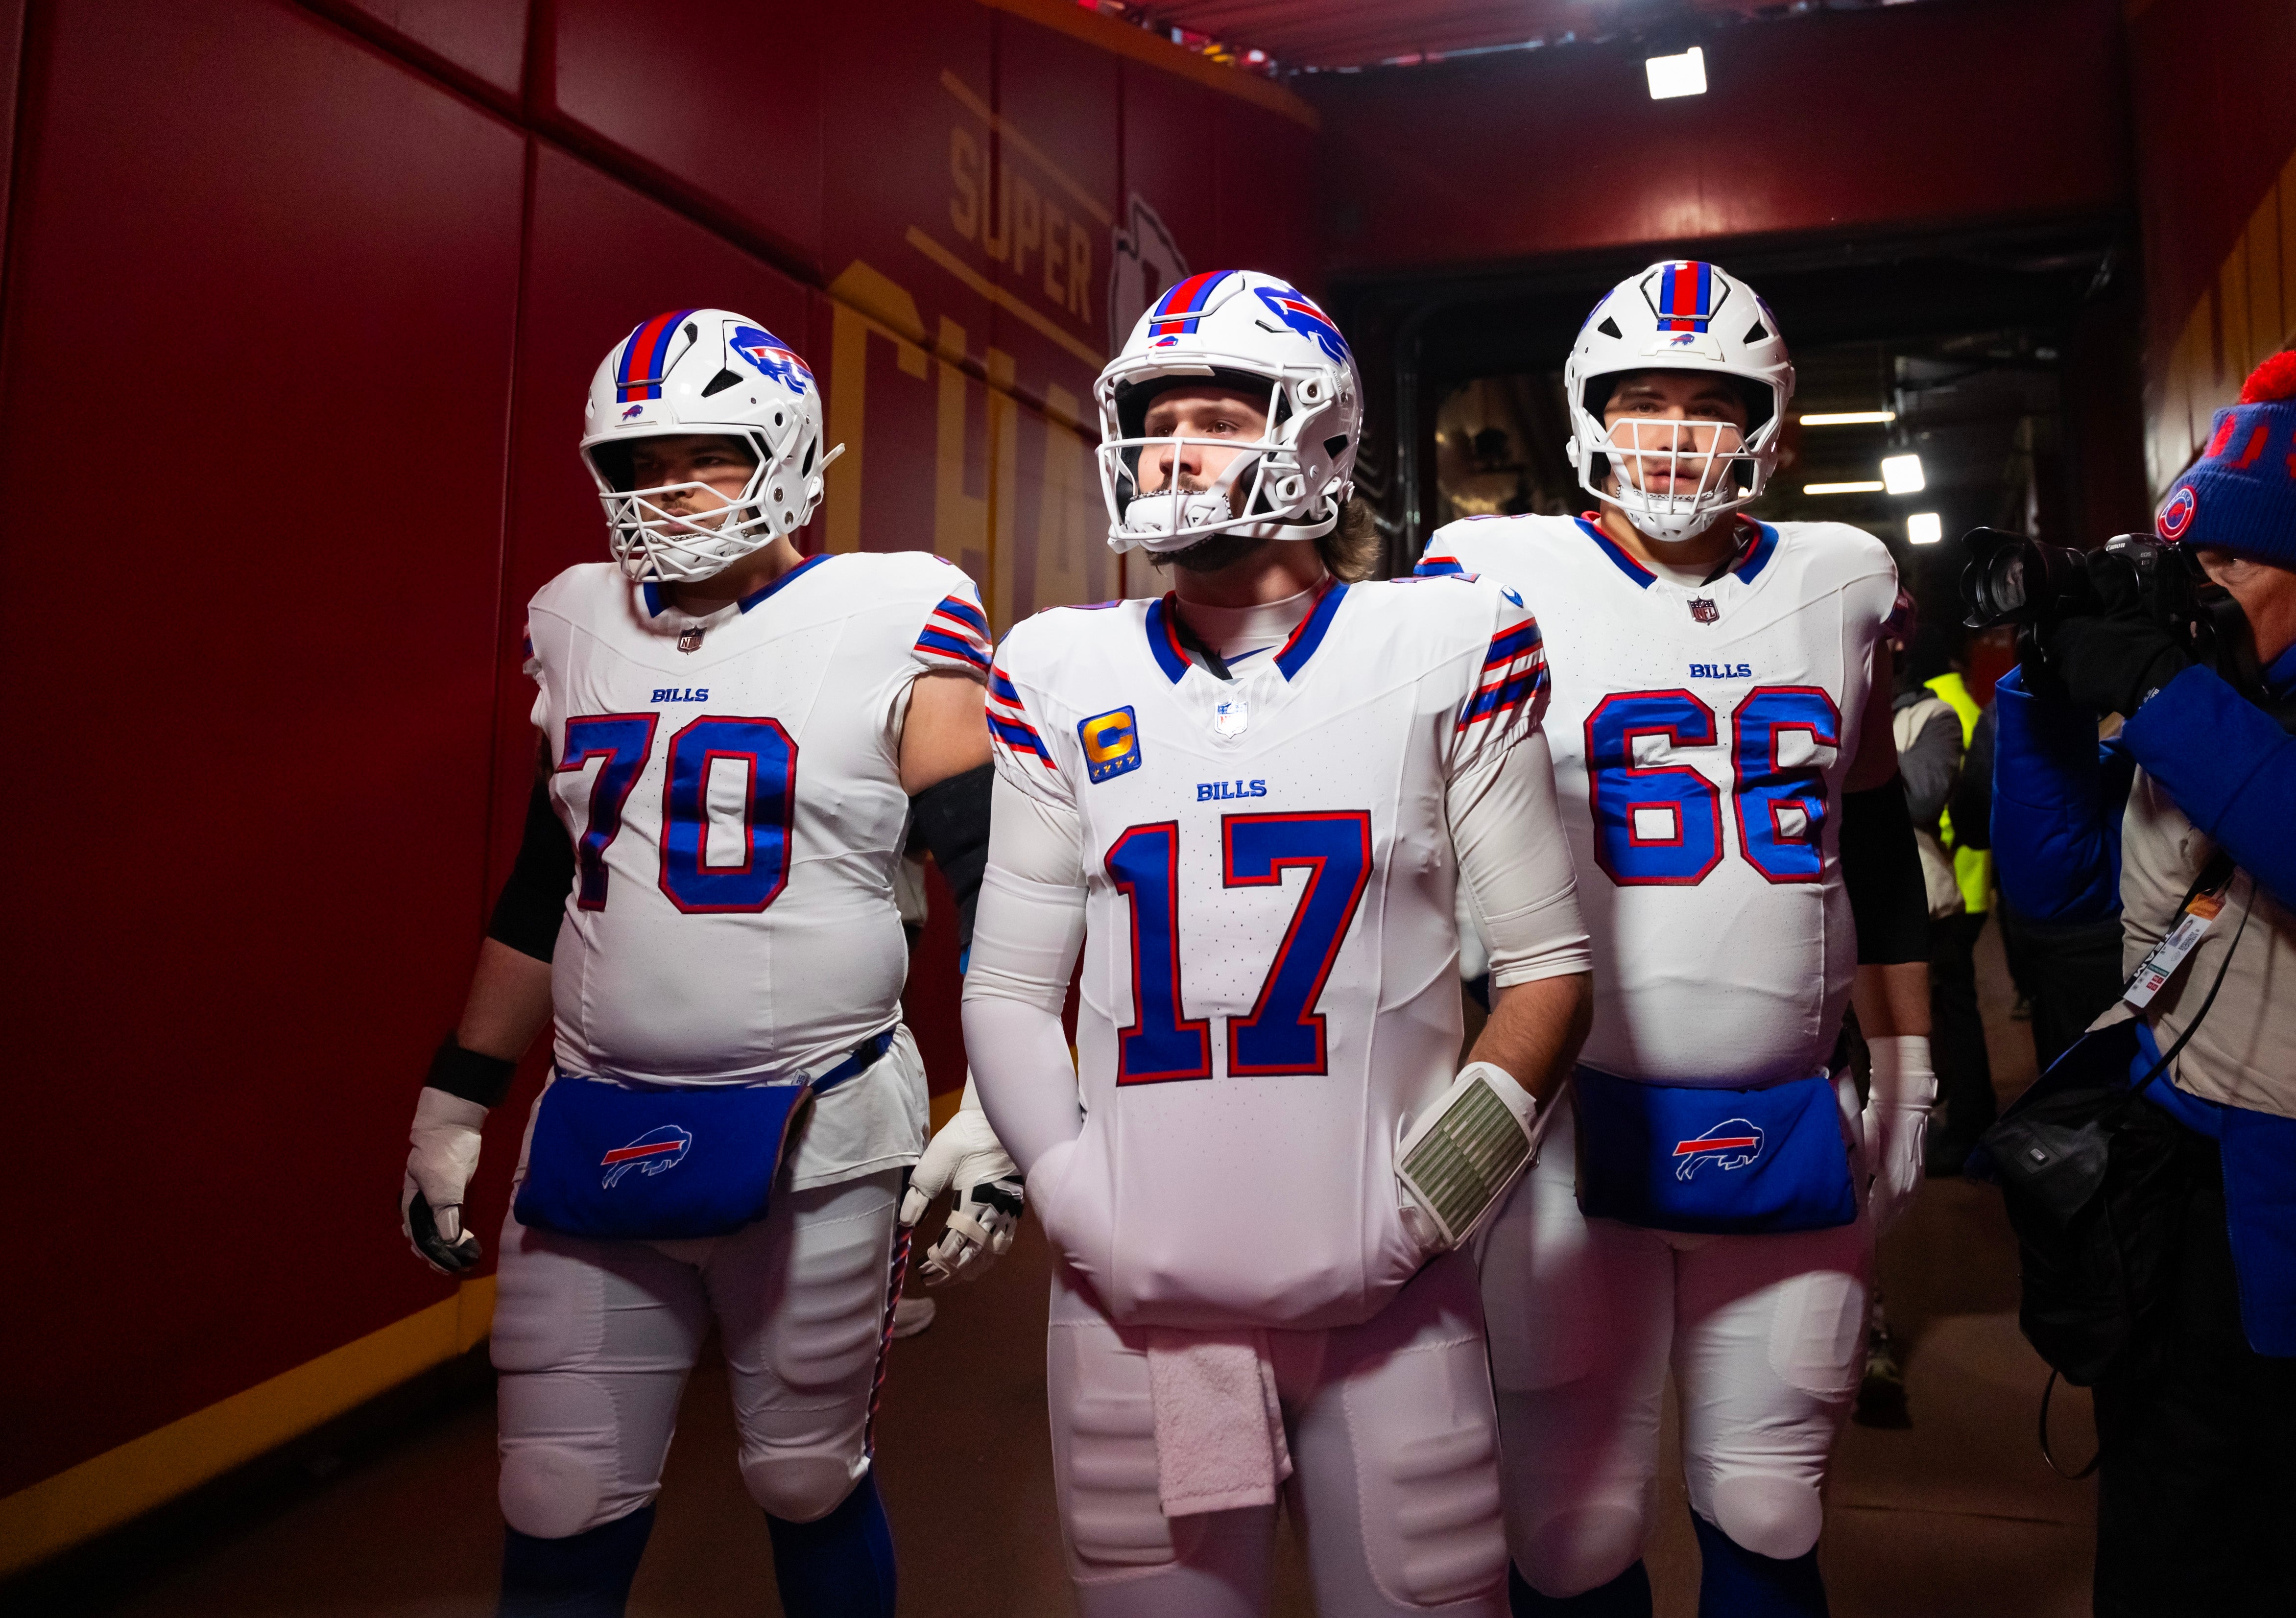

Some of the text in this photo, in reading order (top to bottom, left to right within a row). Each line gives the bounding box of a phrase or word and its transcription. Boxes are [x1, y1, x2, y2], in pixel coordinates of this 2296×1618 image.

[950, 127, 1092, 324] SUPER
[2105, 543, 2126, 551] Canon
[1694, 608, 1716, 619] NFL
[1689, 663, 1752, 679] BILLS
[650, 689, 709, 703] BILLS
[1083, 711, 1133, 764] C
[1196, 779, 1268, 802] BILLS
[1583, 685, 1842, 886] 66
[556, 712, 799, 914] 70
[1103, 809, 1374, 1088] 17
[2133, 931, 2174, 977] TEAM
